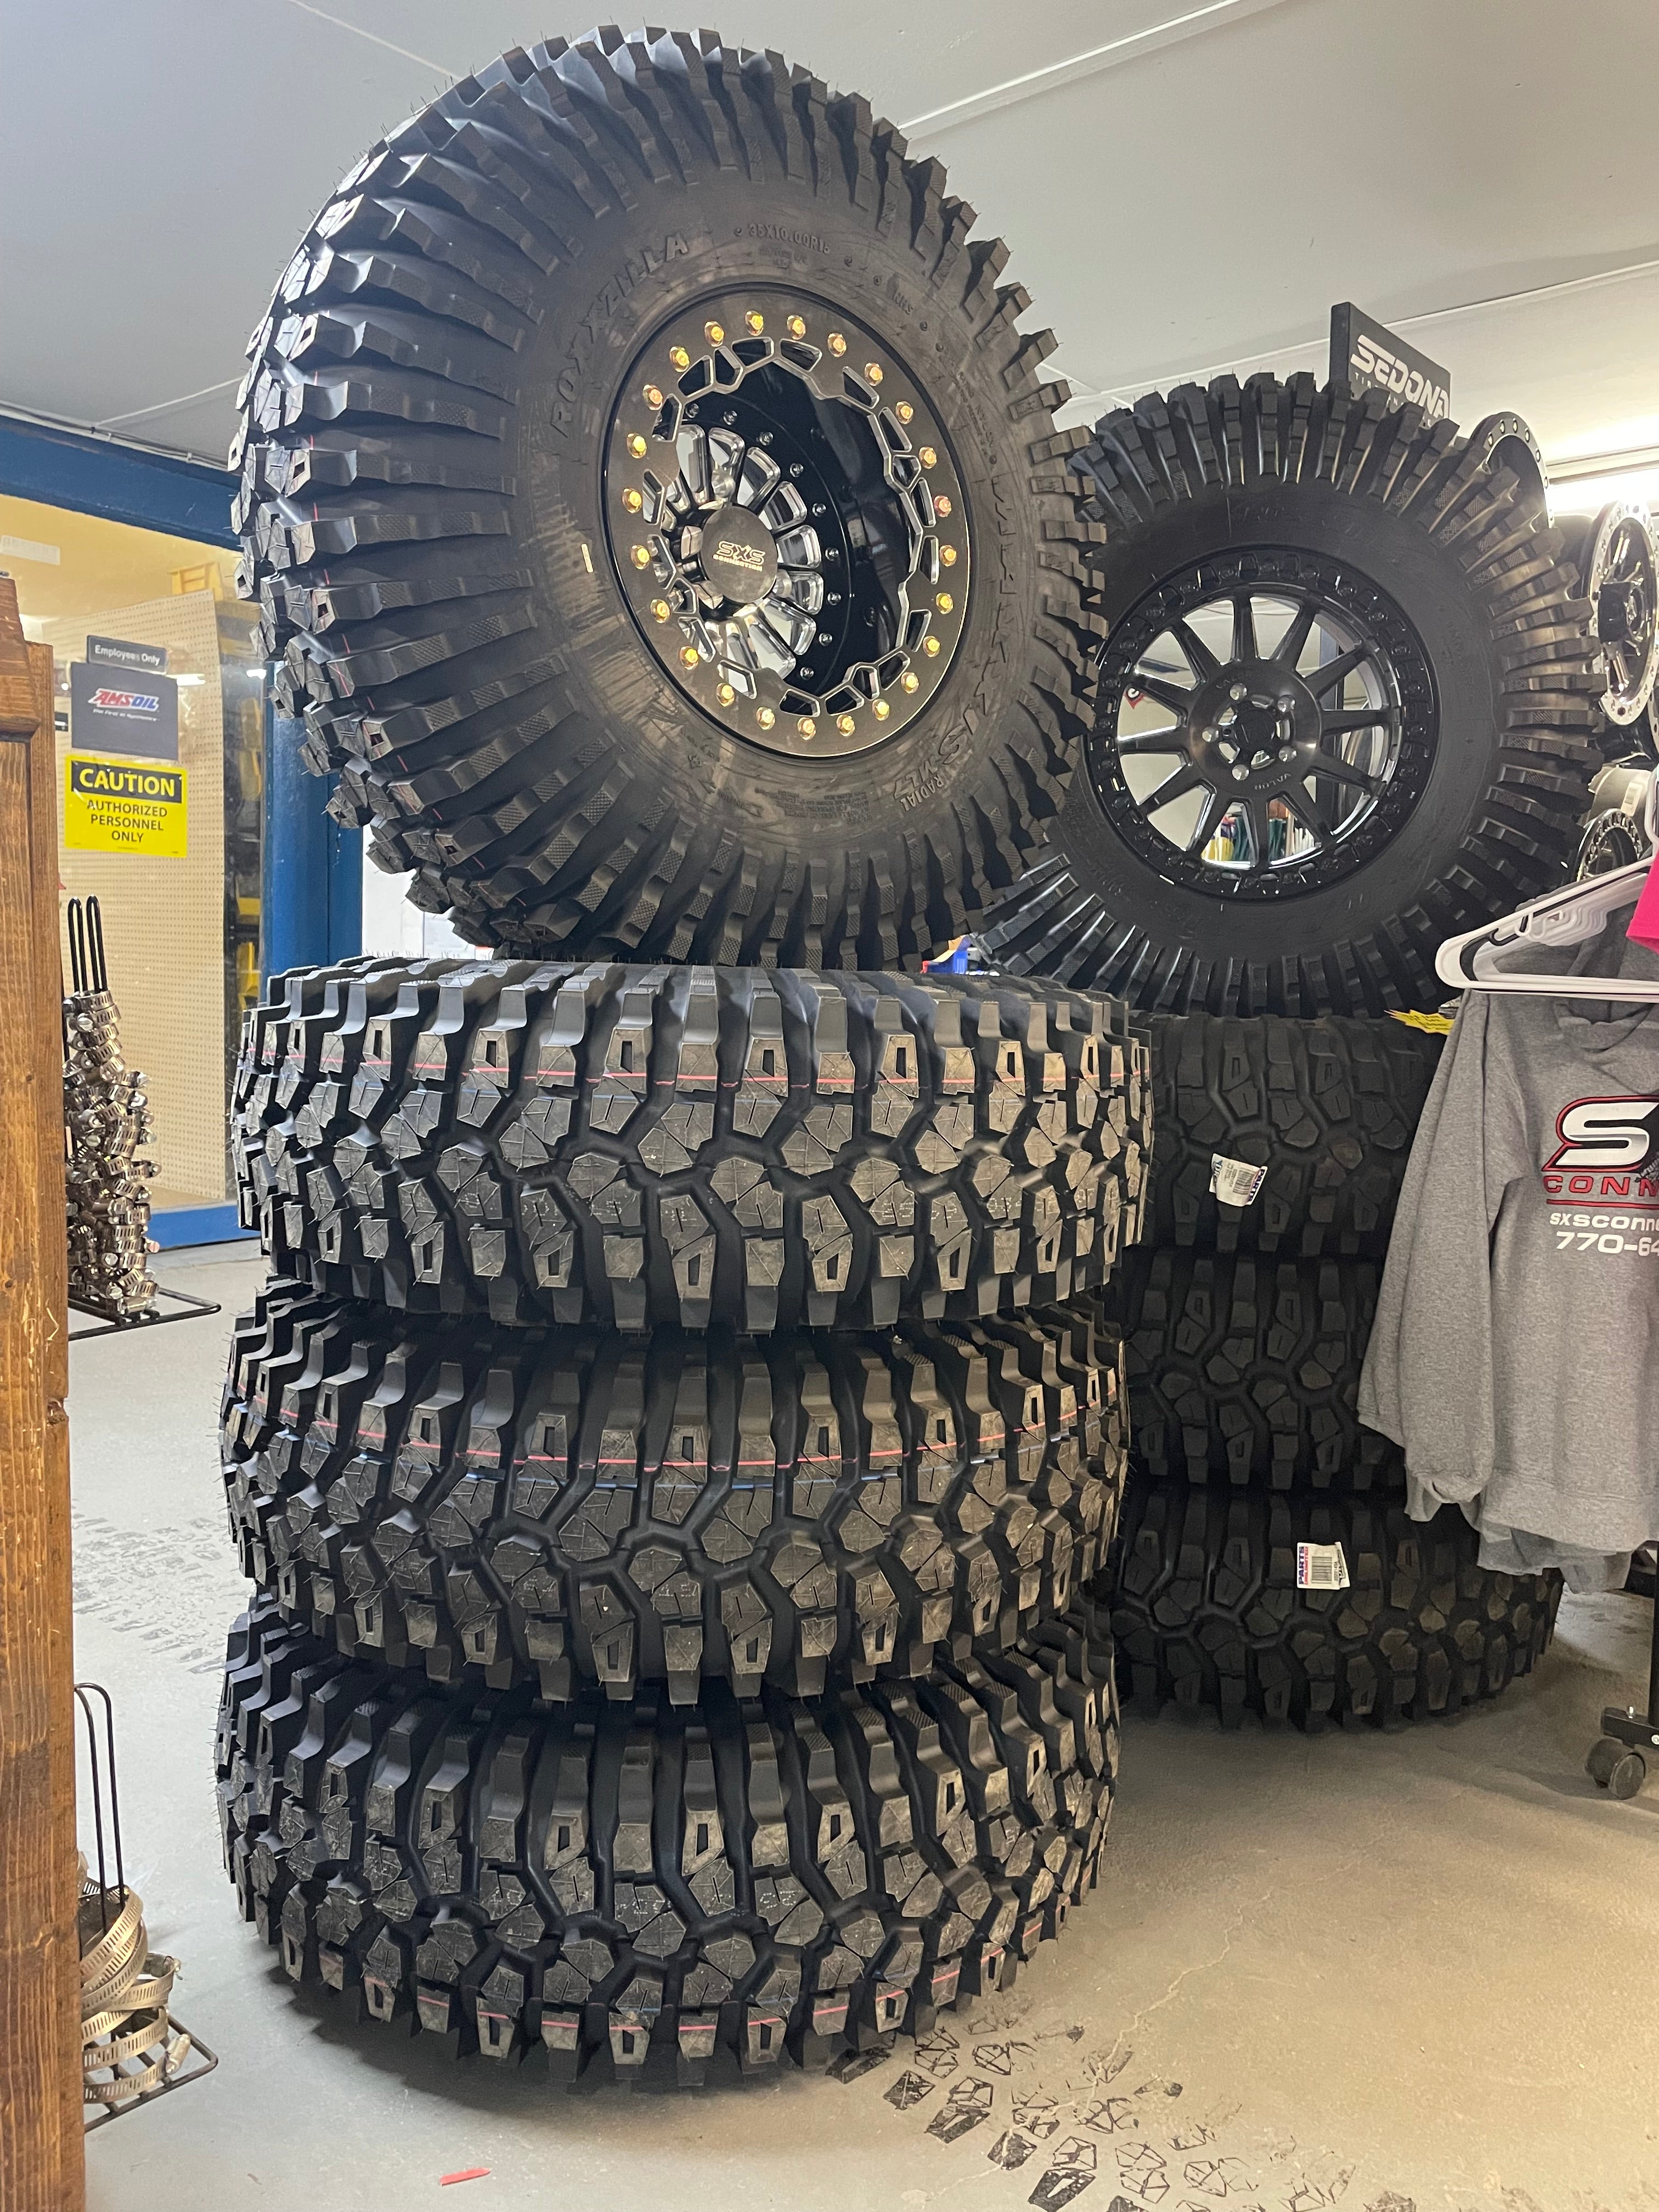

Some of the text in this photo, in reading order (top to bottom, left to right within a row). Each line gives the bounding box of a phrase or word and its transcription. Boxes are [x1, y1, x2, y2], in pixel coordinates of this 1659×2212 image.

[1351, 335, 1449, 419] SEDONA
[1355, 372, 1378, 389] TIR
[716, 540, 765, 565] SXS
[142, 653, 160, 666] Only
[88, 688, 159, 712] AMSOIL
[79, 768, 174, 797] CAUTION
[900, 774, 944, 811] RADIAL
[87, 799, 167, 817] AUTHORIZED
[91, 814, 164, 831] PERSONNEL
[111, 830, 144, 843] ONLY
